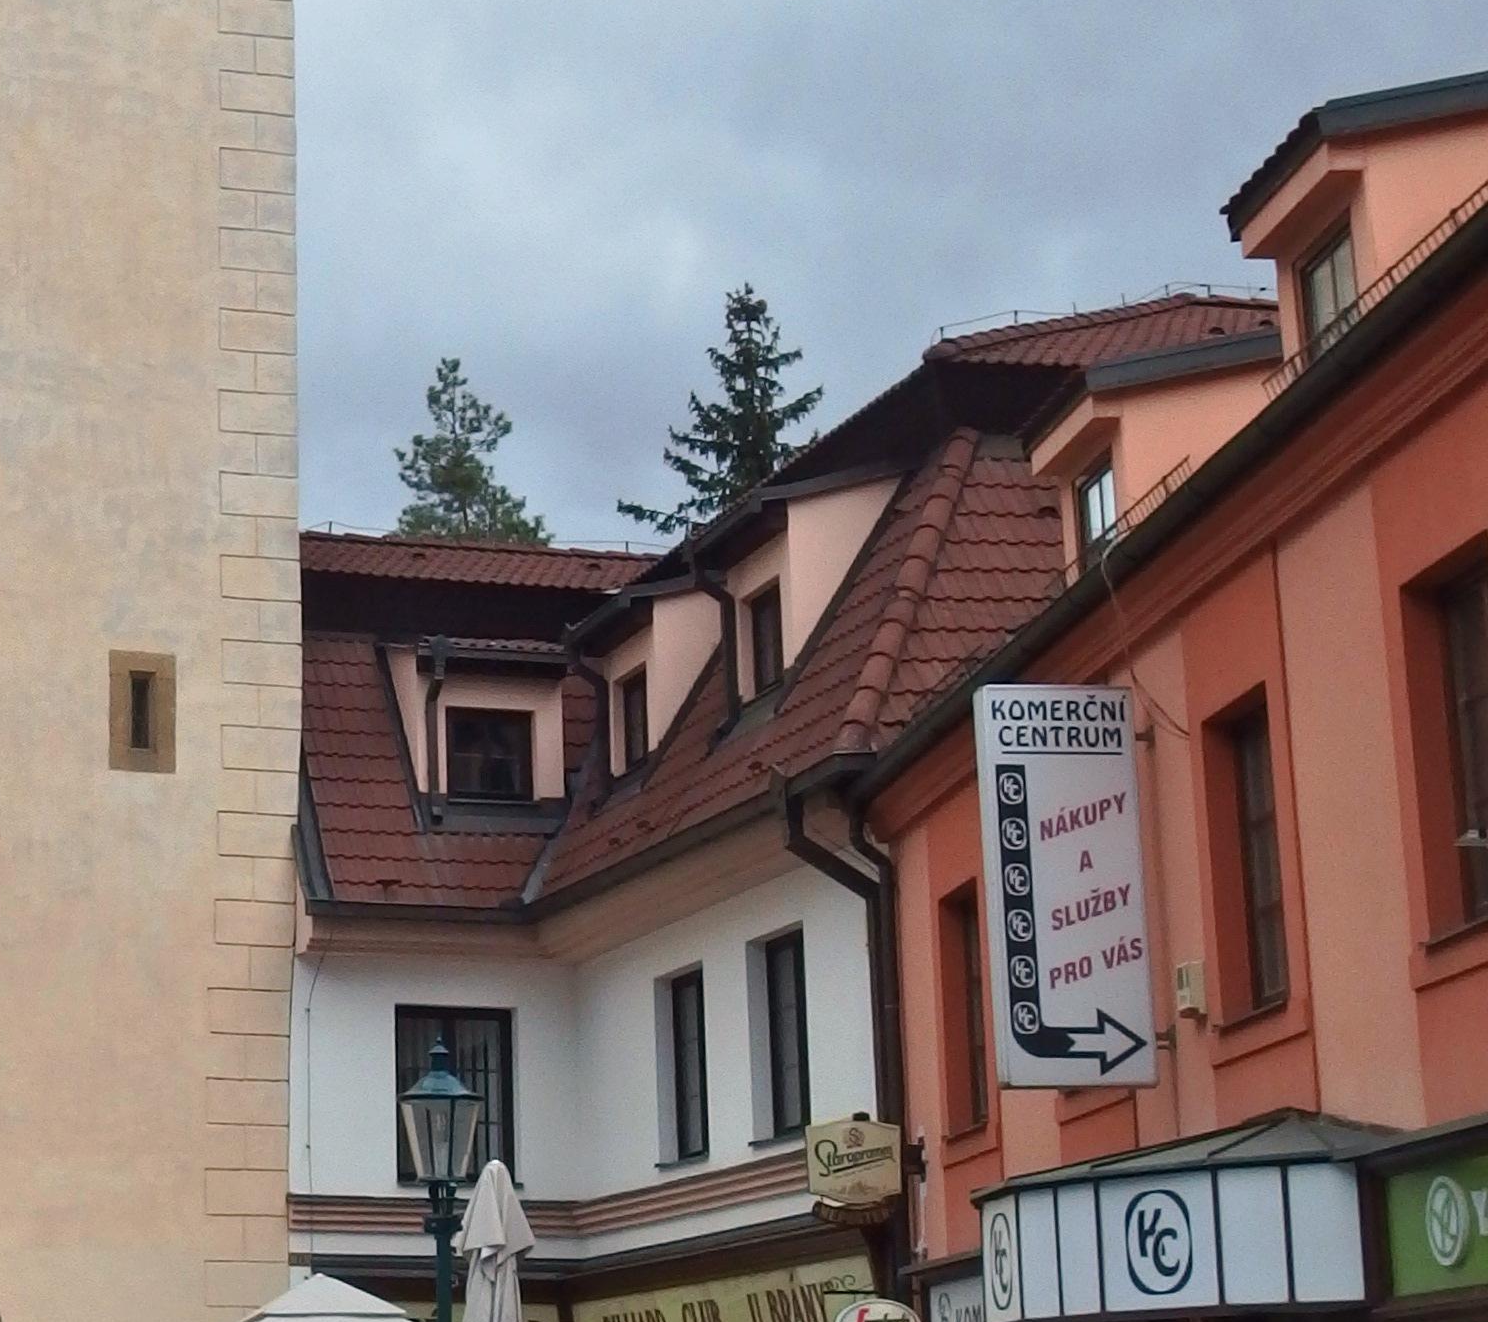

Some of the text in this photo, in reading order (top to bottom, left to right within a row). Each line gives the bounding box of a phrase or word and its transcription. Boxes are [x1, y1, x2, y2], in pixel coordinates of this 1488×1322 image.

[991, 695, 1127, 722] KOMERČNÍ
[998, 726, 1123, 748] CENTRUM
[1039, 792, 1127, 841] NÁKUPY
[1079, 850, 1094, 873] A
[1051, 883, 1131, 931] SLUŽBY
[1048, 935, 1143, 989] PRO VÁS
